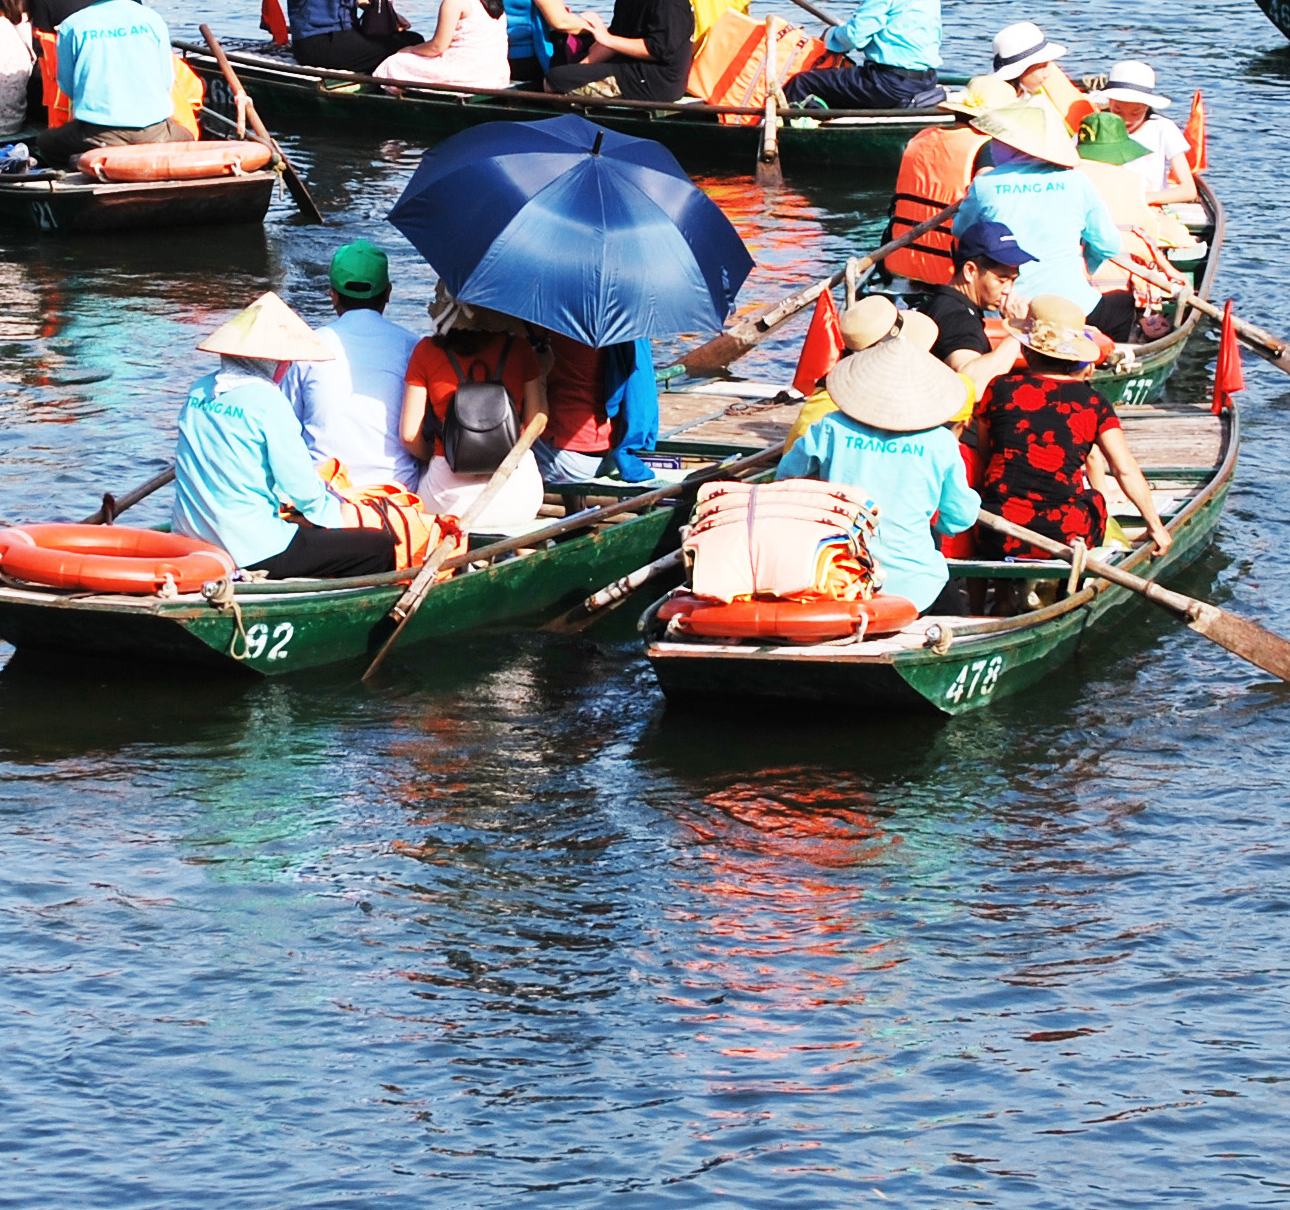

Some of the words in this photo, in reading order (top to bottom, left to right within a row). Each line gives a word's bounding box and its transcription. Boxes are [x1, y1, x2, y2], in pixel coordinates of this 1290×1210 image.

[130, 25, 149, 35] AN
[1045, 181, 1066, 192] AN
[223, 405, 244, 419] AN
[900, 442, 924, 458] AN
[245, 621, 295, 662] 92
[945, 656, 1003, 704] 478
